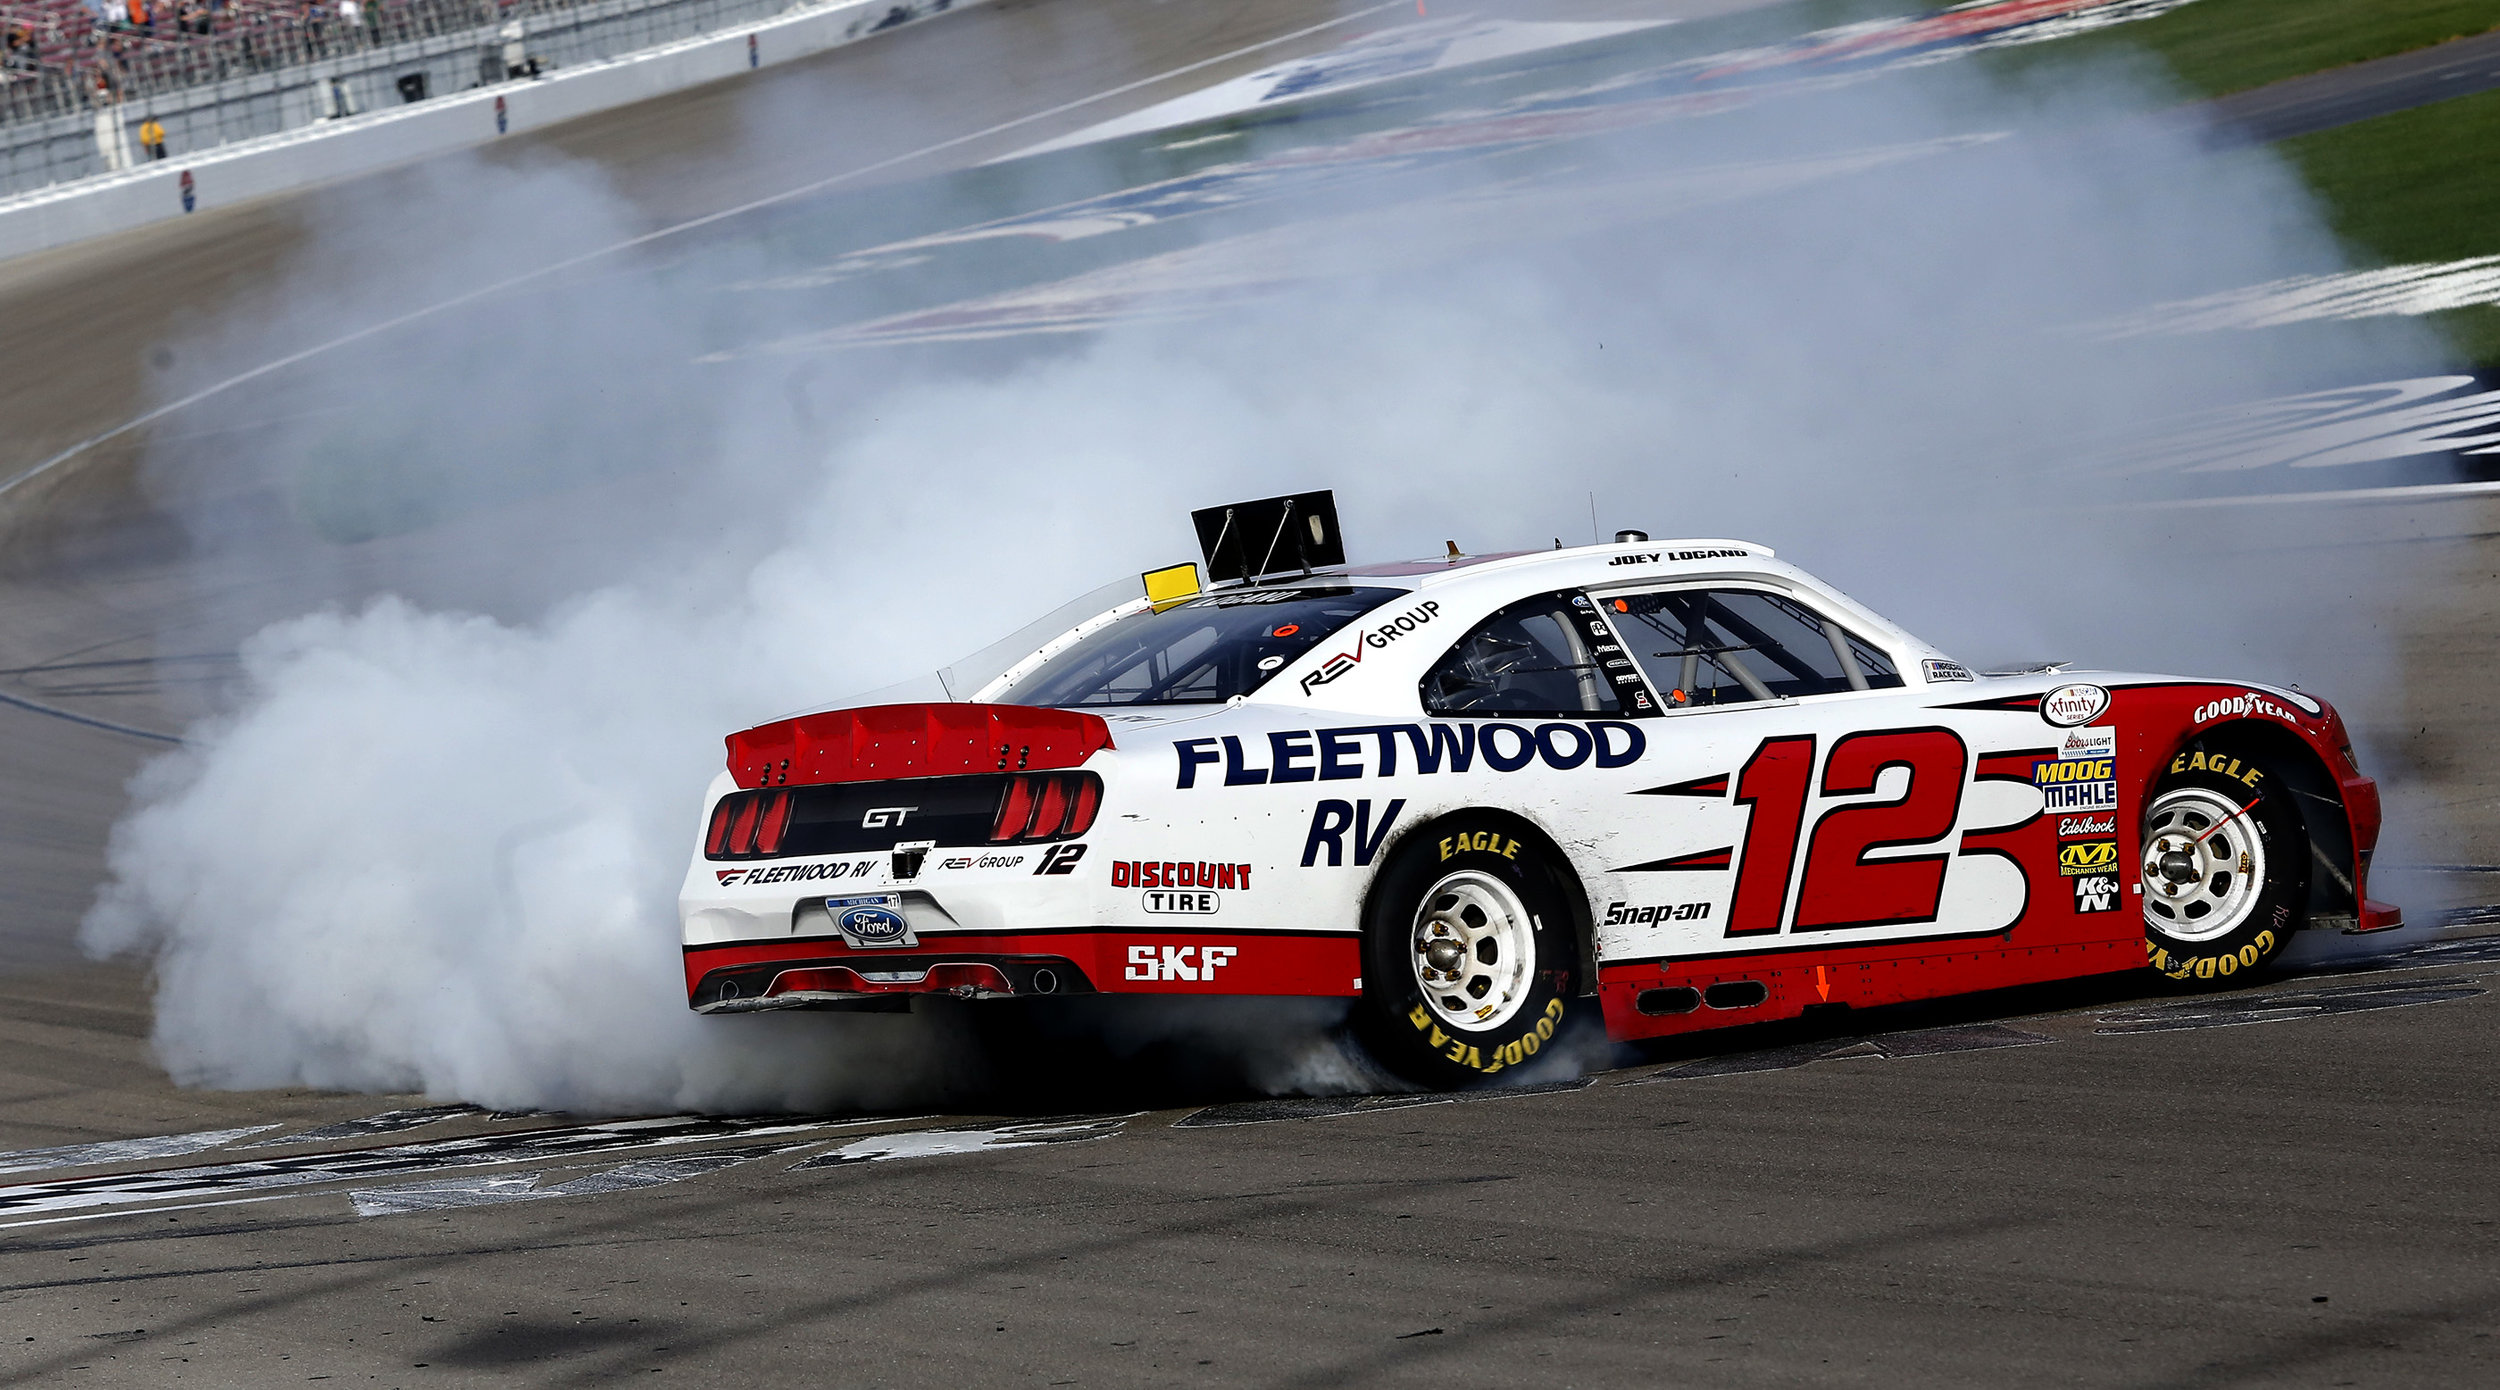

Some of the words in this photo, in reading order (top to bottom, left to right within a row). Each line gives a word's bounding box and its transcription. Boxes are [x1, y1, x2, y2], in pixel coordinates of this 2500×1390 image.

[1608, 553, 1660, 566] JOEY
[1669, 550, 1748, 561] LOGANO
[1300, 630, 1363, 697] REV
[1366, 601, 1440, 649] GROUP
[1932, 671, 1952, 679] RACE
[1952, 671, 1968, 679] CAR
[2049, 697, 2096, 716] xfinity
[2064, 735, 2089, 748] Coors
[2090, 737, 2112, 746] LIGHT
[1173, 721, 1647, 790] FLEETWOOD
[2035, 759, 2113, 784] MOOG
[2171, 751, 2264, 788] EAGLE
[2044, 782, 2115, 808] MAHLE
[862, 806, 919, 828] GT
[2059, 816, 2116, 836] Edelbrock
[1300, 798, 1407, 867] RV
[1724, 725, 1968, 939] 12
[1439, 831, 1522, 862] EAGLE
[937, 852, 990, 870] REV
[979, 856, 1024, 868] GROUP
[1032, 843, 1088, 876] 12
[2060, 866, 2097, 876] MECHANIX
[2097, 862, 2118, 873] WEAR
[743, 862, 850, 885] FLEETWOOD
[850, 860, 878, 878] RV
[1111, 860, 1252, 890] DISCOUNT
[846, 897, 880, 906] MICHIGAN
[888, 896, 897, 907] 17
[1150, 893, 1211, 911] TIRE
[854, 912, 894, 934] Ford
[1603, 901, 1711, 928] Snap-on
[1125, 945, 1238, 981] SKF
[1408, 997, 1565, 1073] GOODYEAR
